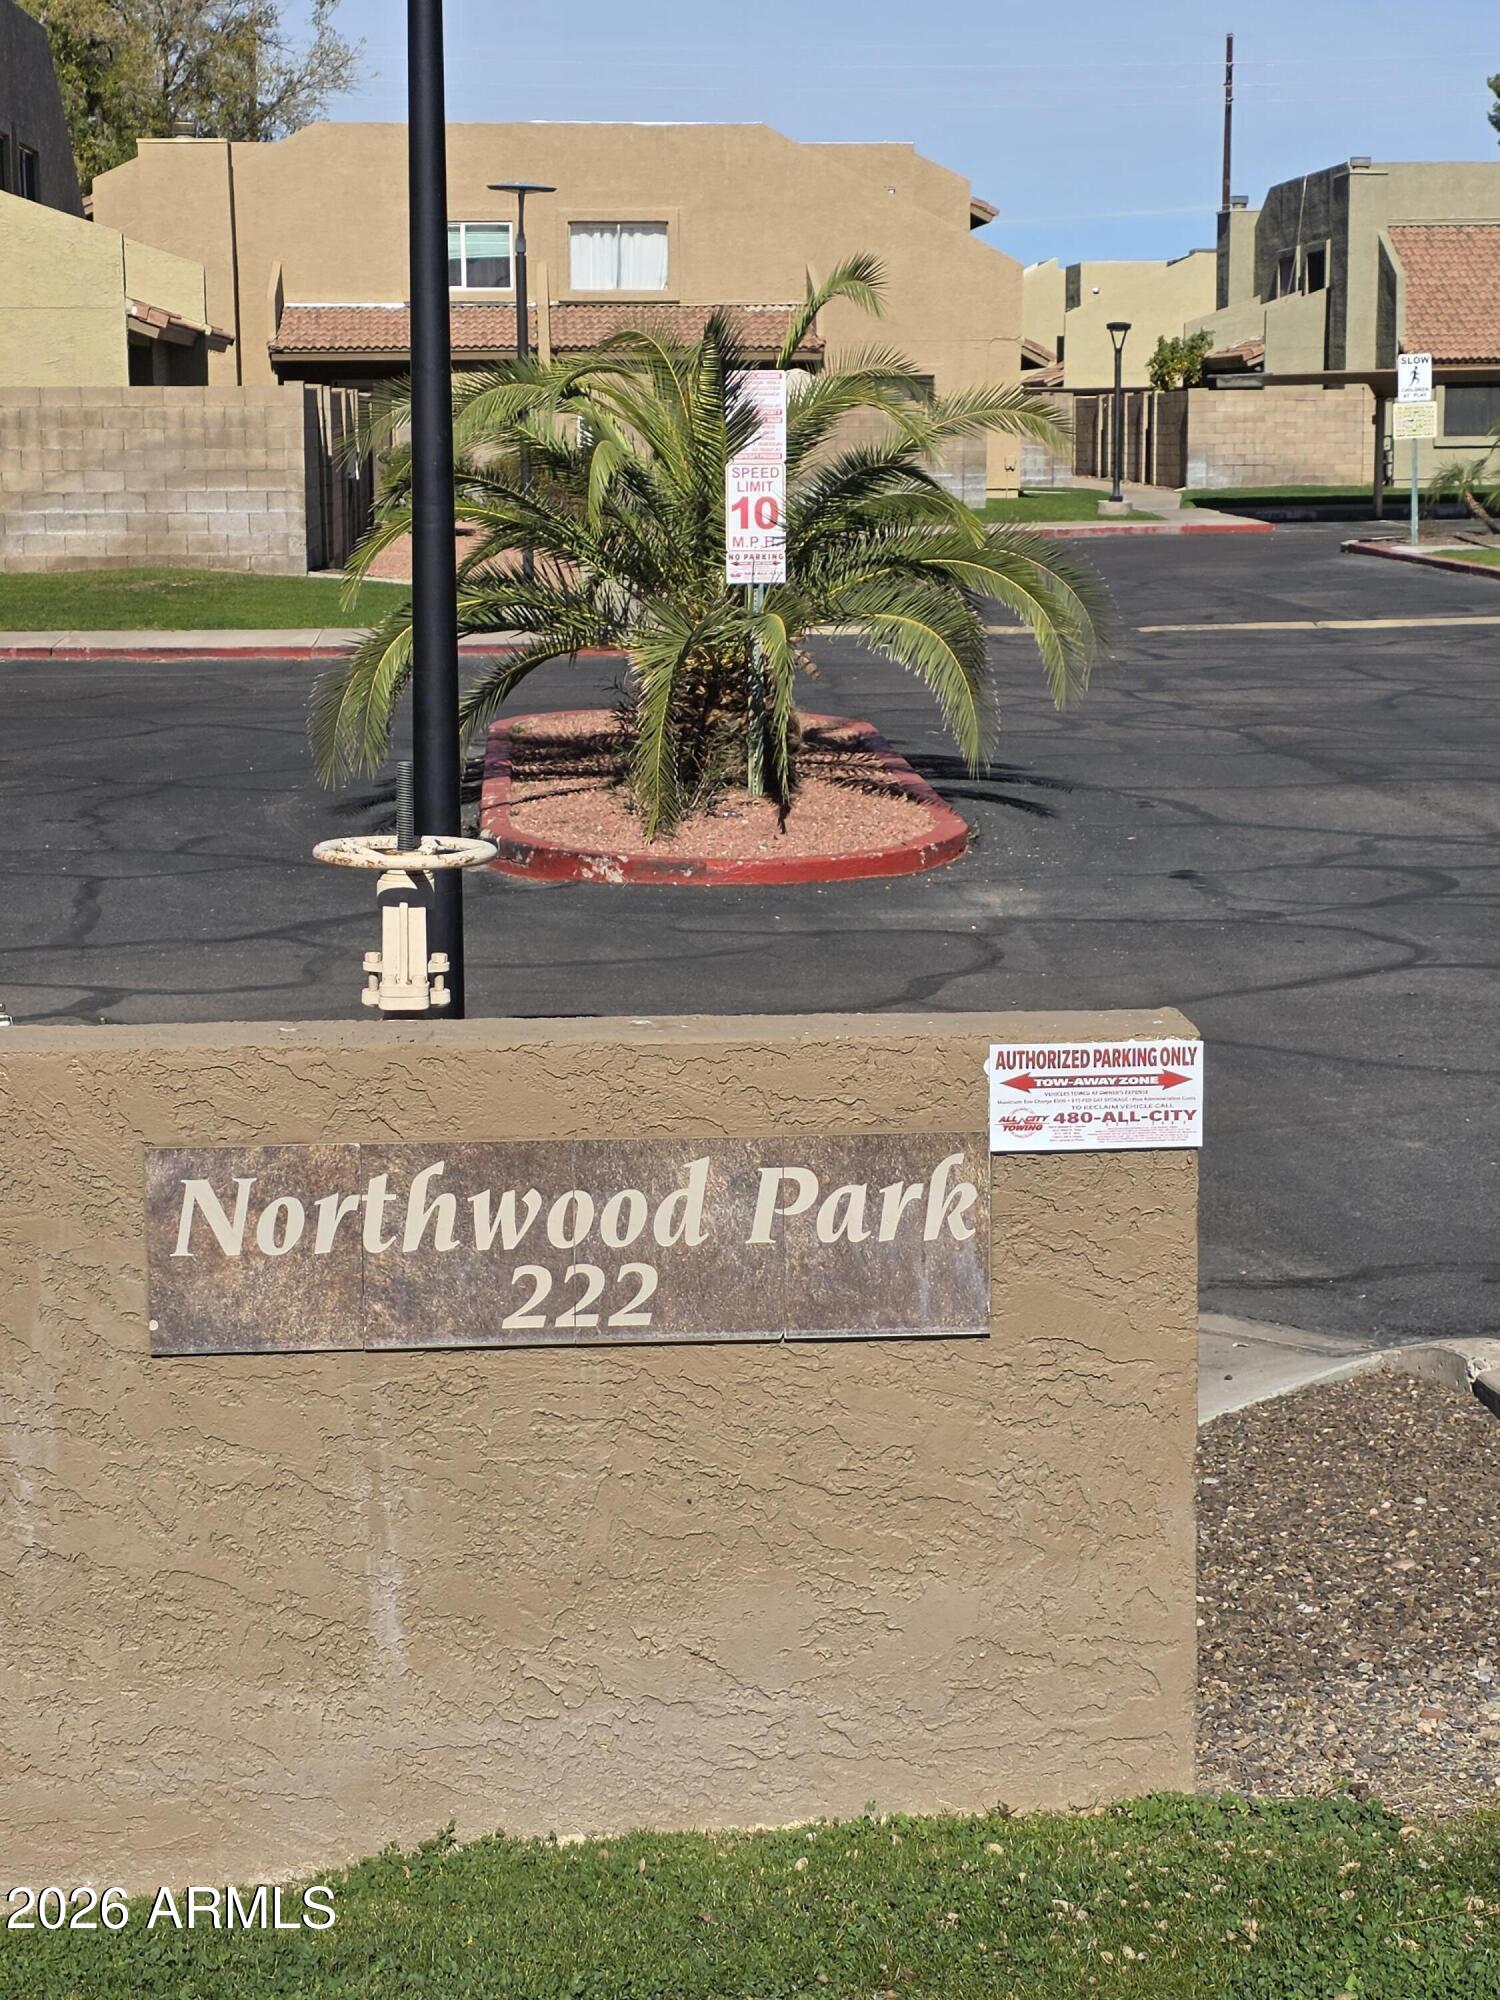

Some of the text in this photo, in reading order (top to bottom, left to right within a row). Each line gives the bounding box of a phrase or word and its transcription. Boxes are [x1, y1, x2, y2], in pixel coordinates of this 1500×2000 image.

[1401, 356, 1430, 365] SLOW
[732, 467, 780, 478] SPEED
[737, 480, 774, 492] LIMIT
[732, 496, 779, 530] 10
[995, 1046, 1198, 1070] AUTHORIZED PARKING ONLY
[1035, 1075, 1159, 1087] TOW-AWAY ZONE
[998, 1115, 1018, 1123] ALL
[1053, 1109, 1197, 1124] 480-ALL-CITY
[170, 1152, 978, 1257] Northwood Park
[502, 1262, 660, 1330] 222
